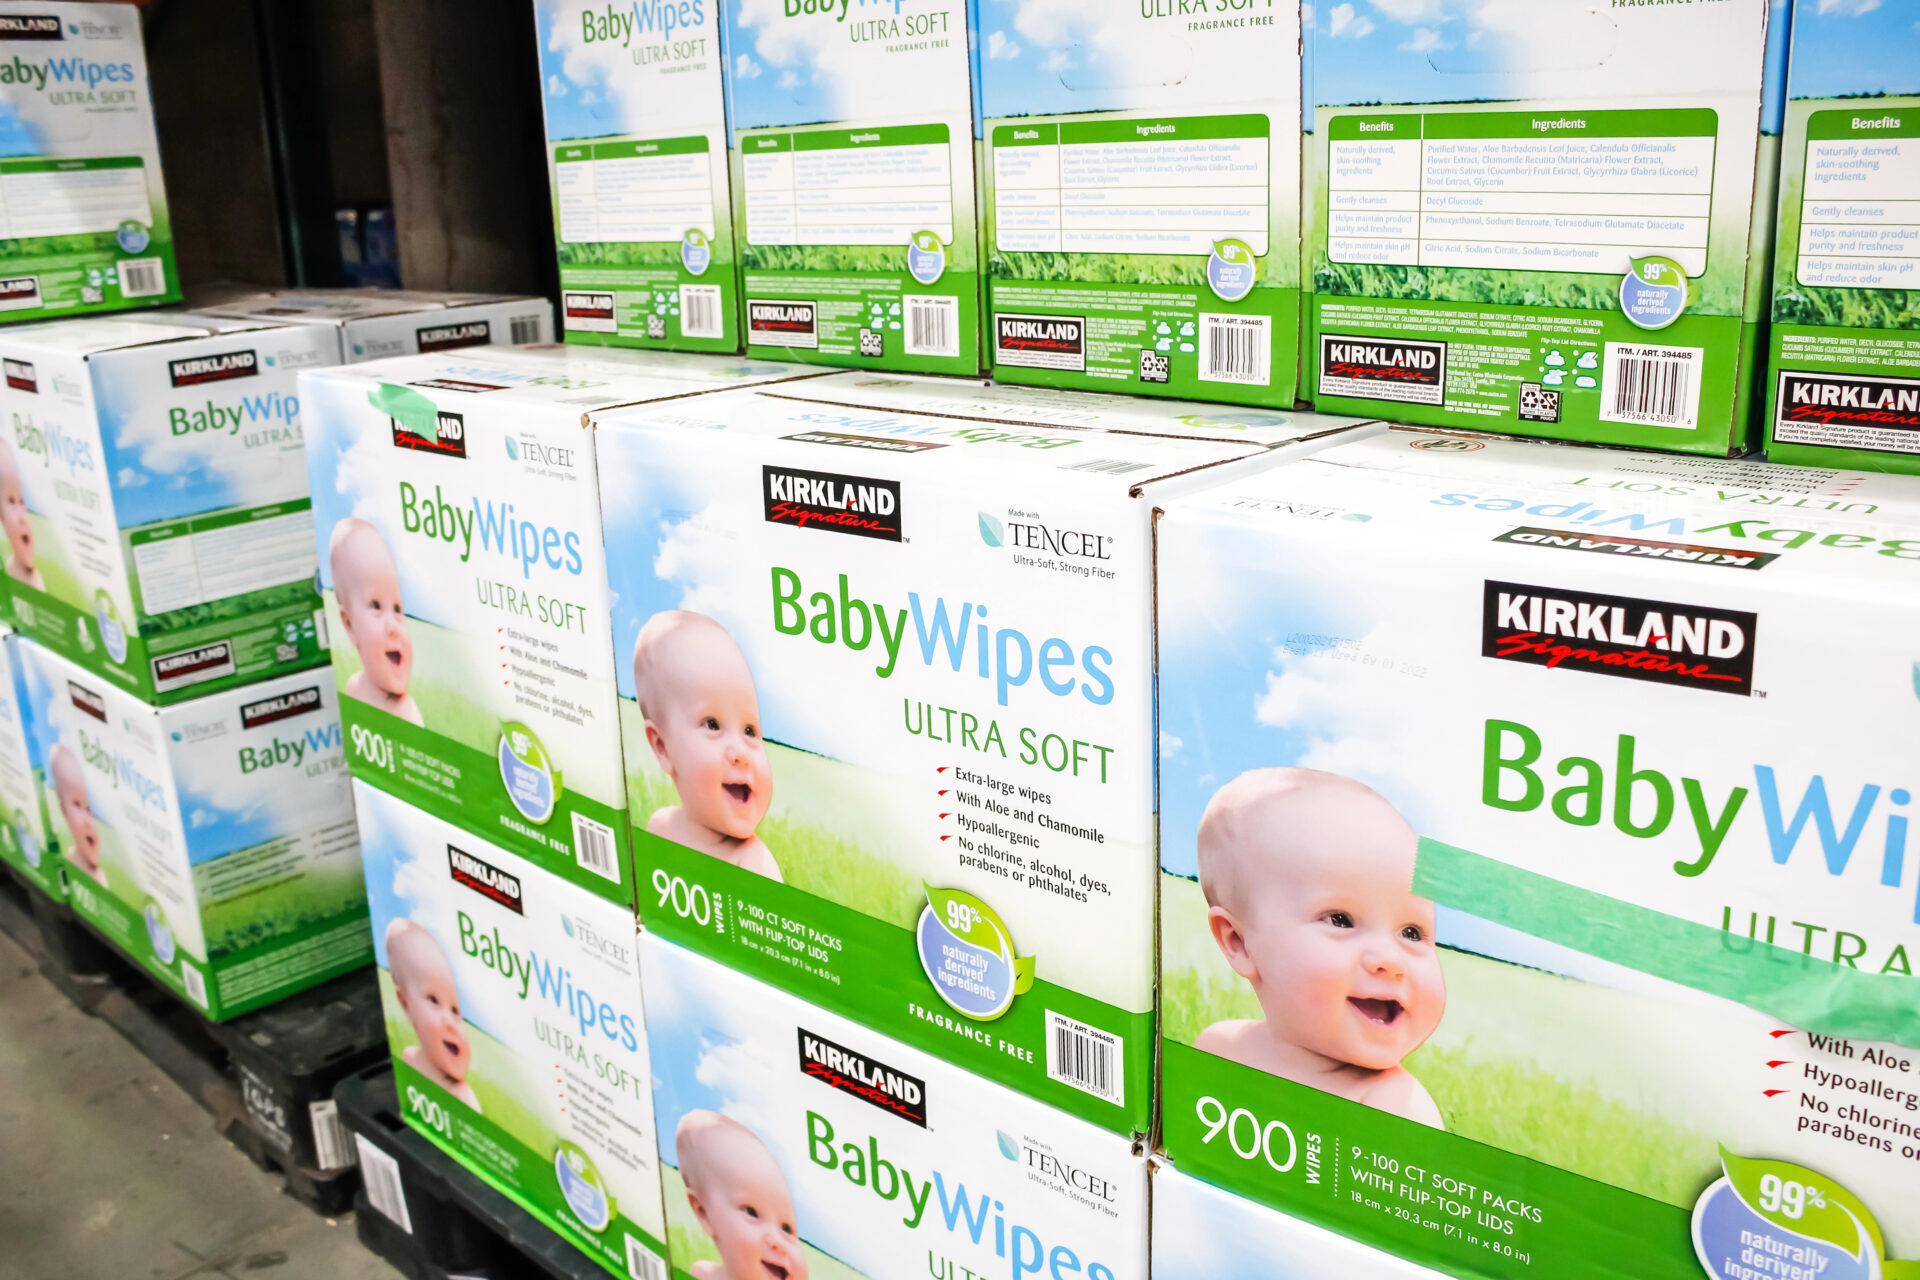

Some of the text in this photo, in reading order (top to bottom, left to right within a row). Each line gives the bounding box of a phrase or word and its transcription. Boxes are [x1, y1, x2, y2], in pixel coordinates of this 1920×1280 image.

[582, 0, 704, 48] BabyWipes
[851, 12, 949, 42] ULTRA SOFT
[1188, 16, 1274, 31] FRAGRANCE FREE
[633, 39, 706, 65] ULTRA SOFT
[1136, 123, 1175, 135] Ingredients
[1360, 121, 1394, 132] Benefits
[1532, 119, 1586, 131] Ingredients
[1851, 117, 1900, 129] Benefits
[1816, 159, 1879, 170] skin-soothing
[1817, 146, 1862, 157] Naturally
[1815, 171, 1867, 182] ingredients
[1812, 207, 1884, 218] Gently cleanses
[1809, 241, 1904, 252] purity and freshness
[1810, 228, 1918, 241] Helps maintain product
[1644, 263, 1667, 280] 99%
[1806, 273, 1882, 284] and reduce odor
[1807, 261, 1913, 274] Helps maintain skin pH
[1632, 305, 1671, 316] ingredients
[1637, 290, 1668, 299] naturally
[1638, 298, 1663, 307] derived
[752, 306, 812, 322] KIRKLAND
[1001, 320, 1078, 340] KIRKLAND
[173, 353, 255, 378] KIRKLAND
[1330, 344, 1436, 369] KIRKLAND
[1618, 347, 1692, 359] ITM. ART. 394485
[1792, 382, 1920, 412] KIRKLAN
[770, 473, 894, 516] KIRKLAND
[399, 481, 583, 579] BabyWipes
[771, 501, 896, 532] Signature
[1008, 509, 1039, 520] Made with
[1013, 554, 1115, 579] Ultra-Soft, Strong Fiber
[476, 578, 587, 634] ULTRA SOFT
[771, 566, 1115, 706] BabyWipes
[1497, 592, 1746, 660] KIRKLAND
[1495, 632, 1743, 682] Signature
[351, 724, 386, 768] 900
[904, 698, 1114, 784] ULTRA SOFT
[955, 767, 1052, 805] Extra-large wipes
[957, 790, 1104, 844] With Aloe and Chamomile
[958, 813, 1040, 849] Hypoallergenic
[1482, 718, 1920, 924] BabyWi
[450, 849, 520, 899] KIRKLAND
[958, 836, 1112, 897] No chlorine, alcohol, dyes,
[959, 853, 1088, 903] parabens or phthalates
[652, 869, 710, 925] 900
[715, 892, 725, 934] WIPES
[737, 900, 842, 952] 9-100 CT SOFT PACKS
[946, 900, 982, 933] 99%
[738, 915, 829, 963] WITH FLIP-TOP LIDS
[942, 944, 989, 974] naturally
[945, 958, 984, 983] derived
[457, 910, 637, 1052] BabyWipes
[937, 966, 996, 1002] ingredients
[909, 1003, 1033, 1065] FRAGRANCE FREE
[1055, 1017, 1114, 1044] ITM. ART. 394485
[534, 1016, 640, 1100] ULTRA SOFT
[1808, 1032, 1910, 1072] With Aloe
[804, 1036, 921, 1106] KIRKLAND
[805, 1063, 922, 1120] Signature
[1800, 1093, 1829, 1113] No
[1195, 1096, 1297, 1174] 900
[1798, 1116, 1892, 1153] parabens
[1306, 1132, 1321, 1186] WIPES
[1027, 1171, 1119, 1220] Ultra-Soft, Strong Fiber
[1351, 1146, 1542, 1224] 9-100 CT SOFT PACKS
[1351, 1165, 1514, 1236] WITH FLIP-TOP LIDS
[1759, 1173, 1826, 1220] 99%
[1351, 1190, 1530, 1265] 18 cm 20.3 cm (7.1 in 8.0 in)
[1740, 1229, 1829, 1273] naturally
